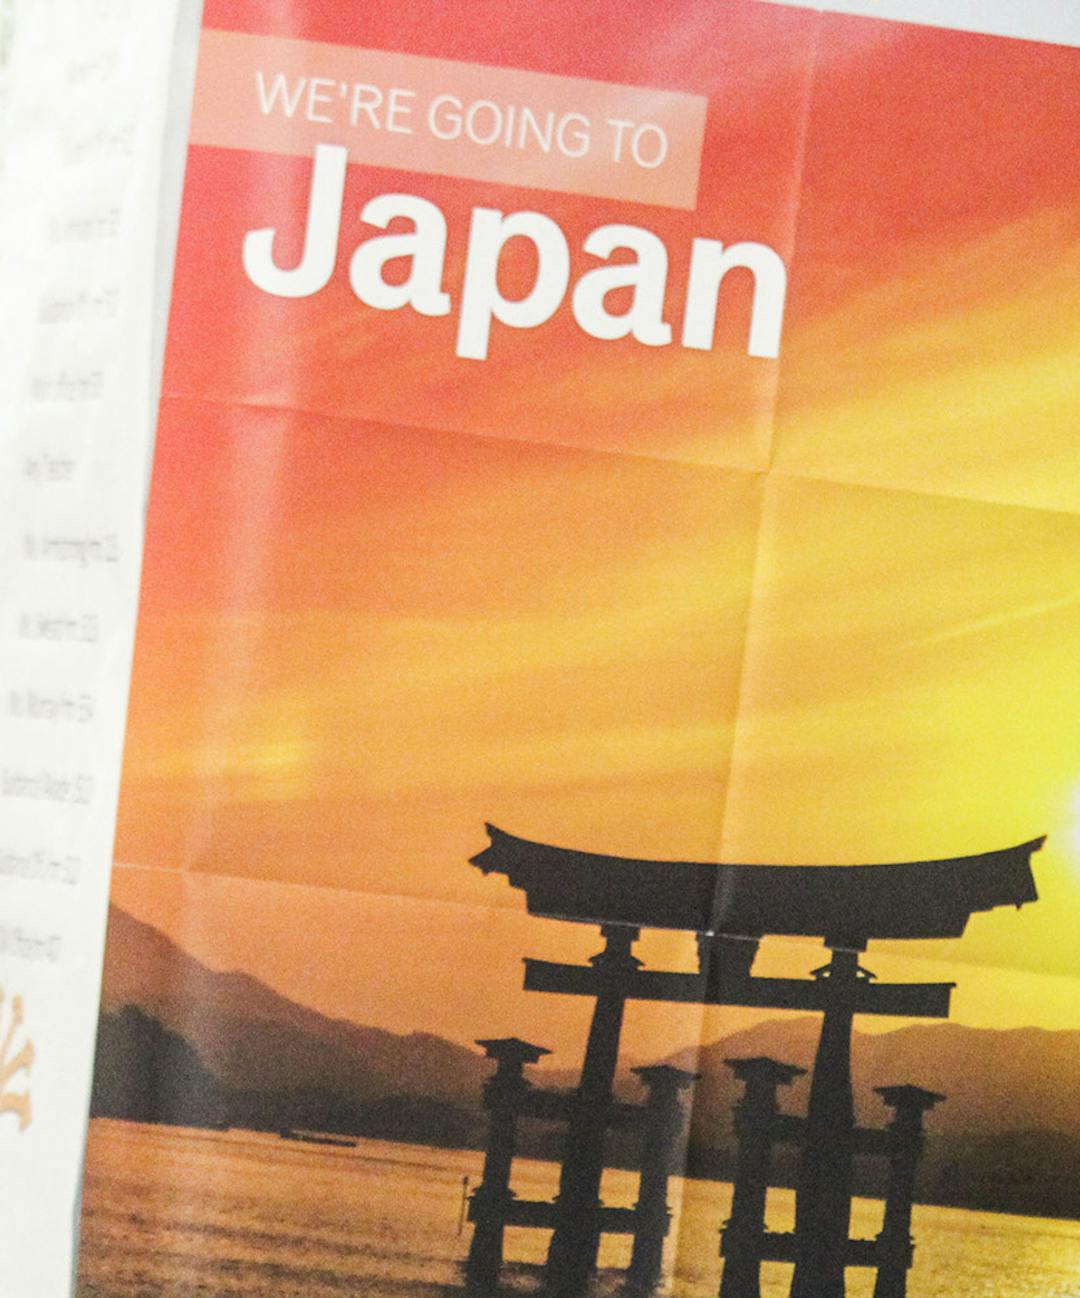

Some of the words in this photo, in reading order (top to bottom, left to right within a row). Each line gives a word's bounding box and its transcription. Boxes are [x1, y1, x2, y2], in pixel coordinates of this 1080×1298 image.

[255, 71, 416, 134] WE'RE
[428, 93, 592, 159] GOING
[606, 118, 669, 169] TO
[242, 143, 788, 361] Japan
